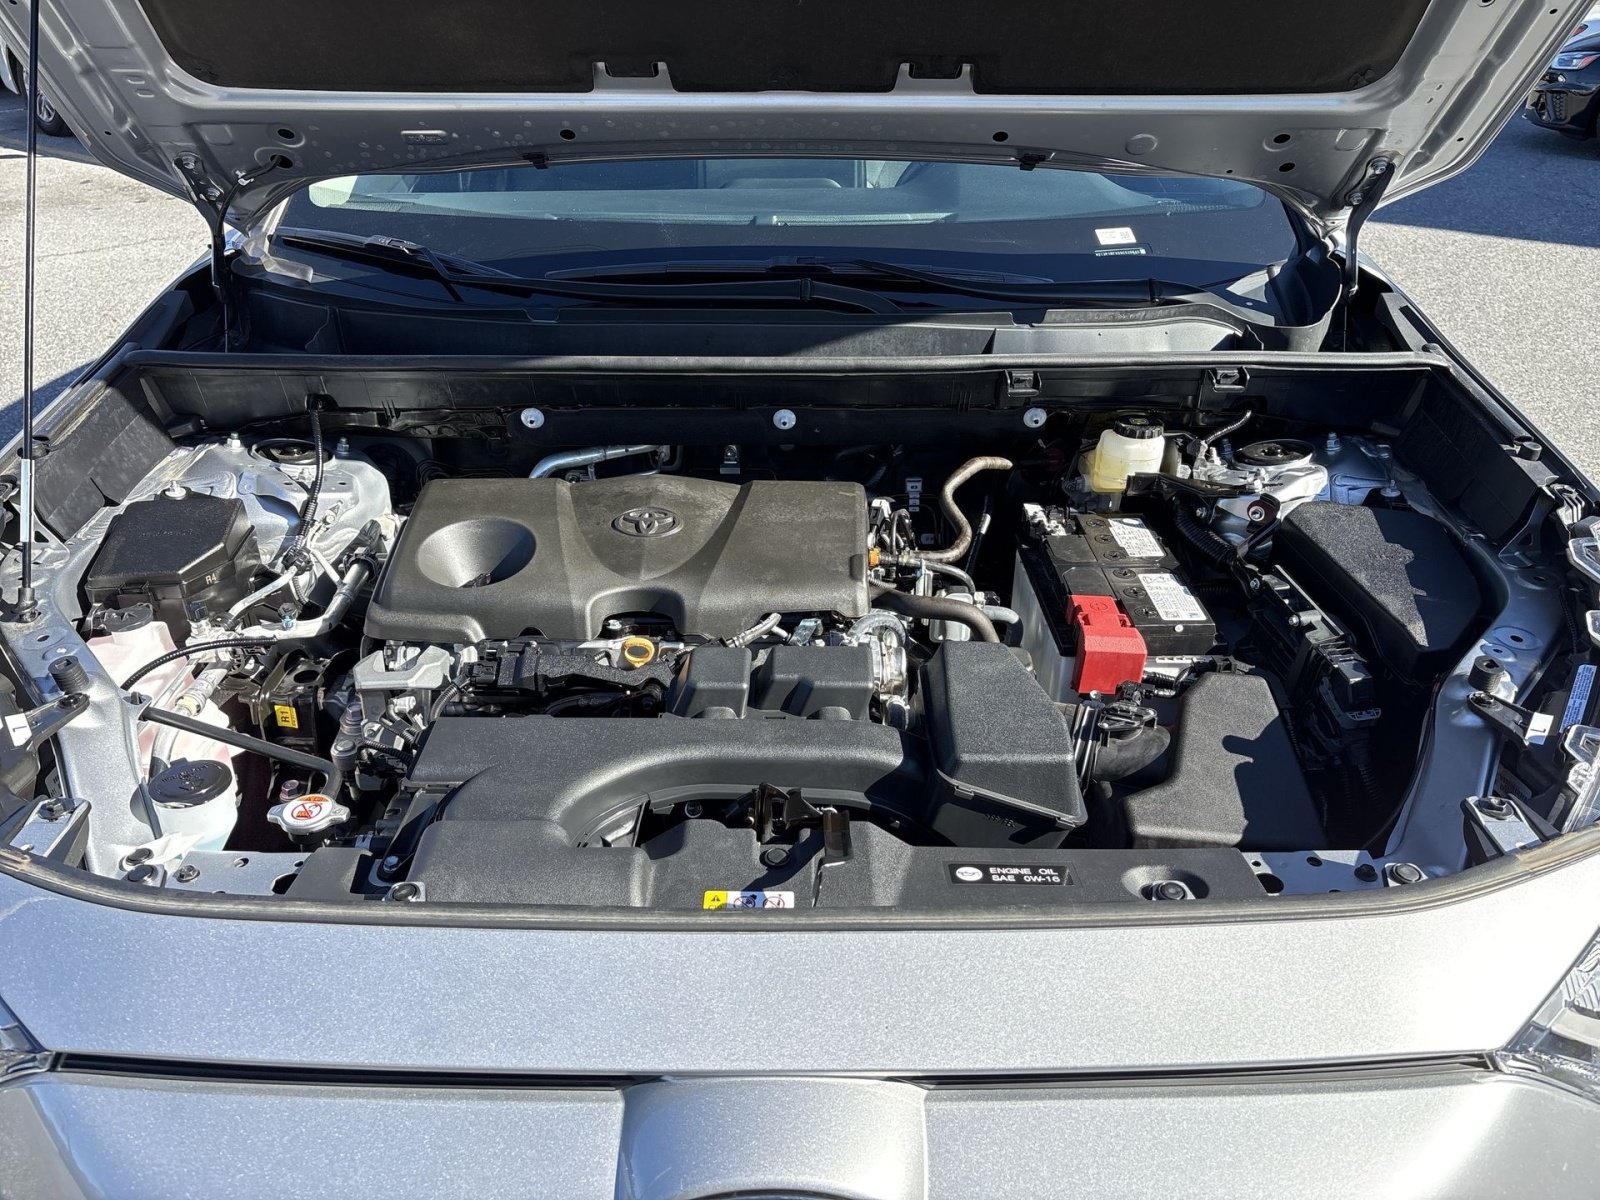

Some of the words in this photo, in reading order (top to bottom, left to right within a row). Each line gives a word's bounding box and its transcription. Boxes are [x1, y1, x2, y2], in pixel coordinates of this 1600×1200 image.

[205, 572, 217, 585] R4
[280, 710, 290, 722] R1
[989, 867, 1032, 875] ENGINE
[992, 874, 1016, 882] SAE
[1023, 875, 1061, 883] 0W-16
